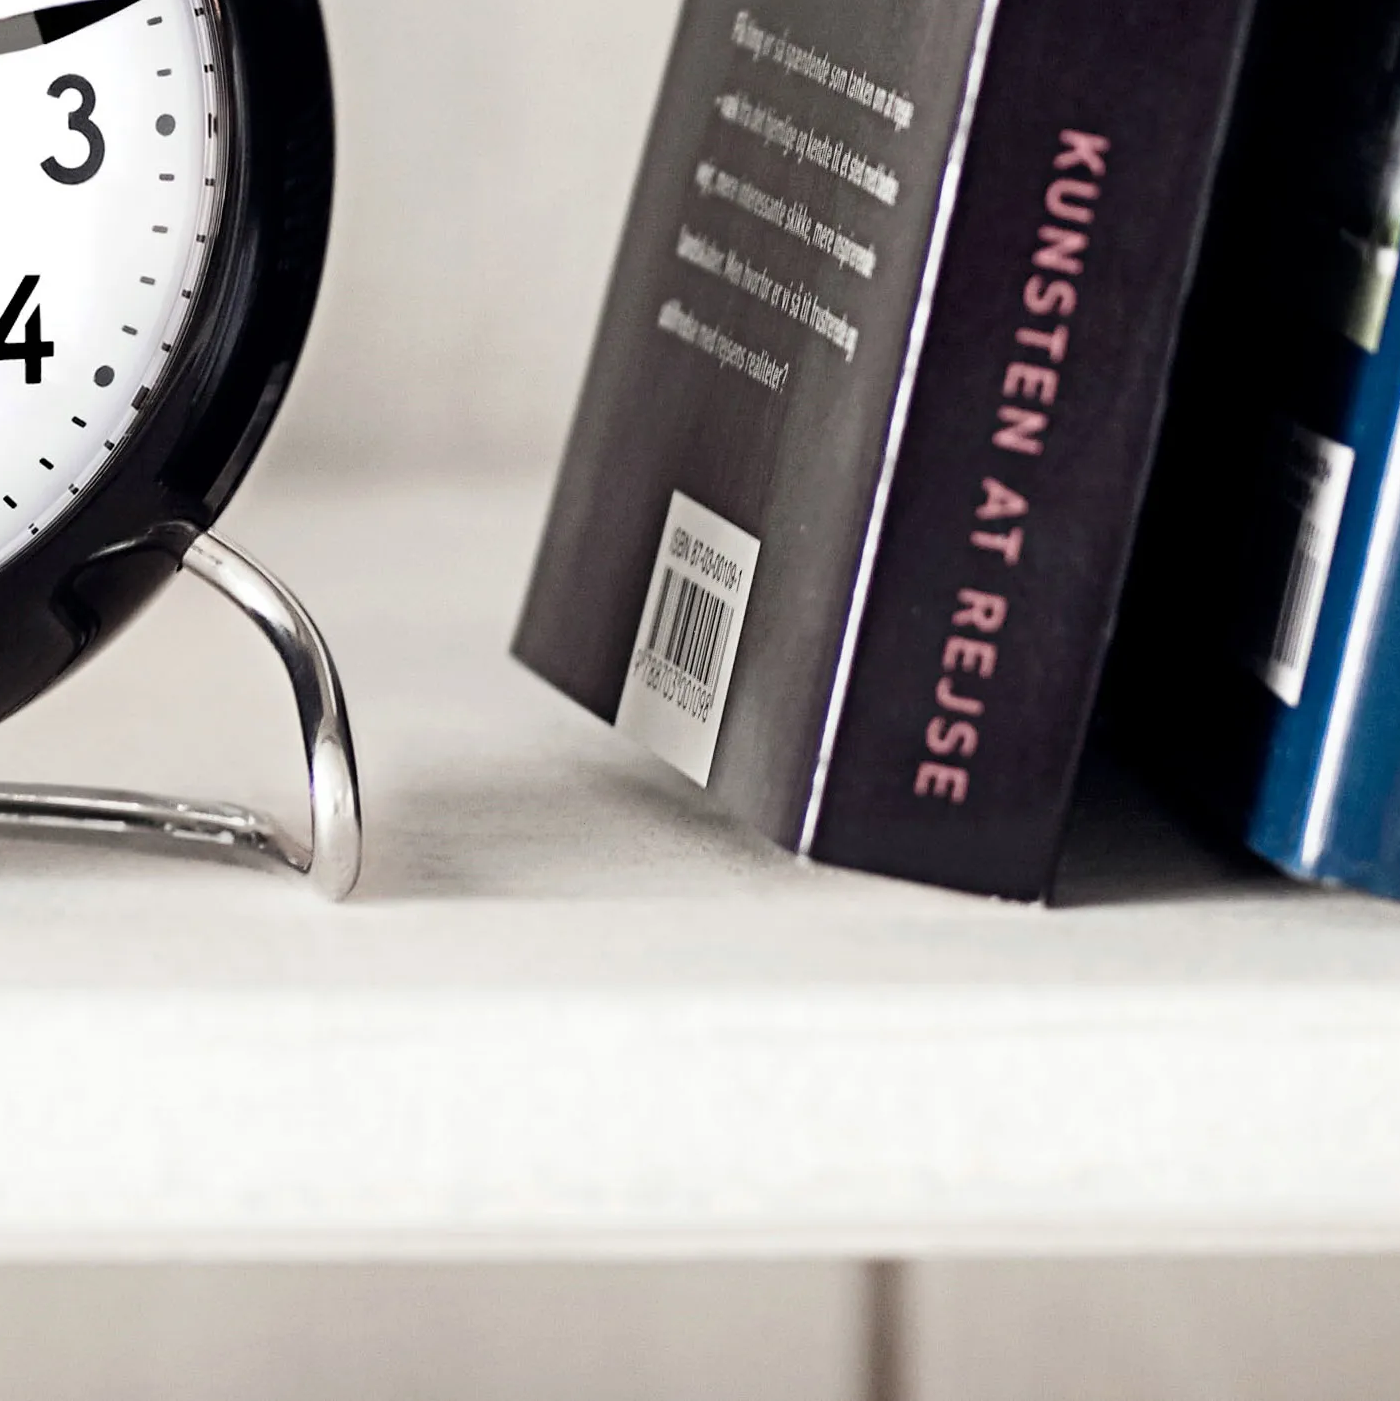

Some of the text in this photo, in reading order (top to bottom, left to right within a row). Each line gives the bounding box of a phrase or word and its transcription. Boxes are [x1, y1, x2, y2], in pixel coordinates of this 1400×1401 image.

[827, 63, 848, 93] som
[845, 68, 875, 107] tanken
[40, 73, 106, 185] 3
[804, 126, 833, 170] kendte
[783, 200, 812, 246] skikke,
[811, 220, 835, 254] mere
[740, 258, 774, 301] hvorfor
[743, 349, 790, 394] realiteter?
[913, 129, 1109, 804] KUNSTEN AT REJSE
